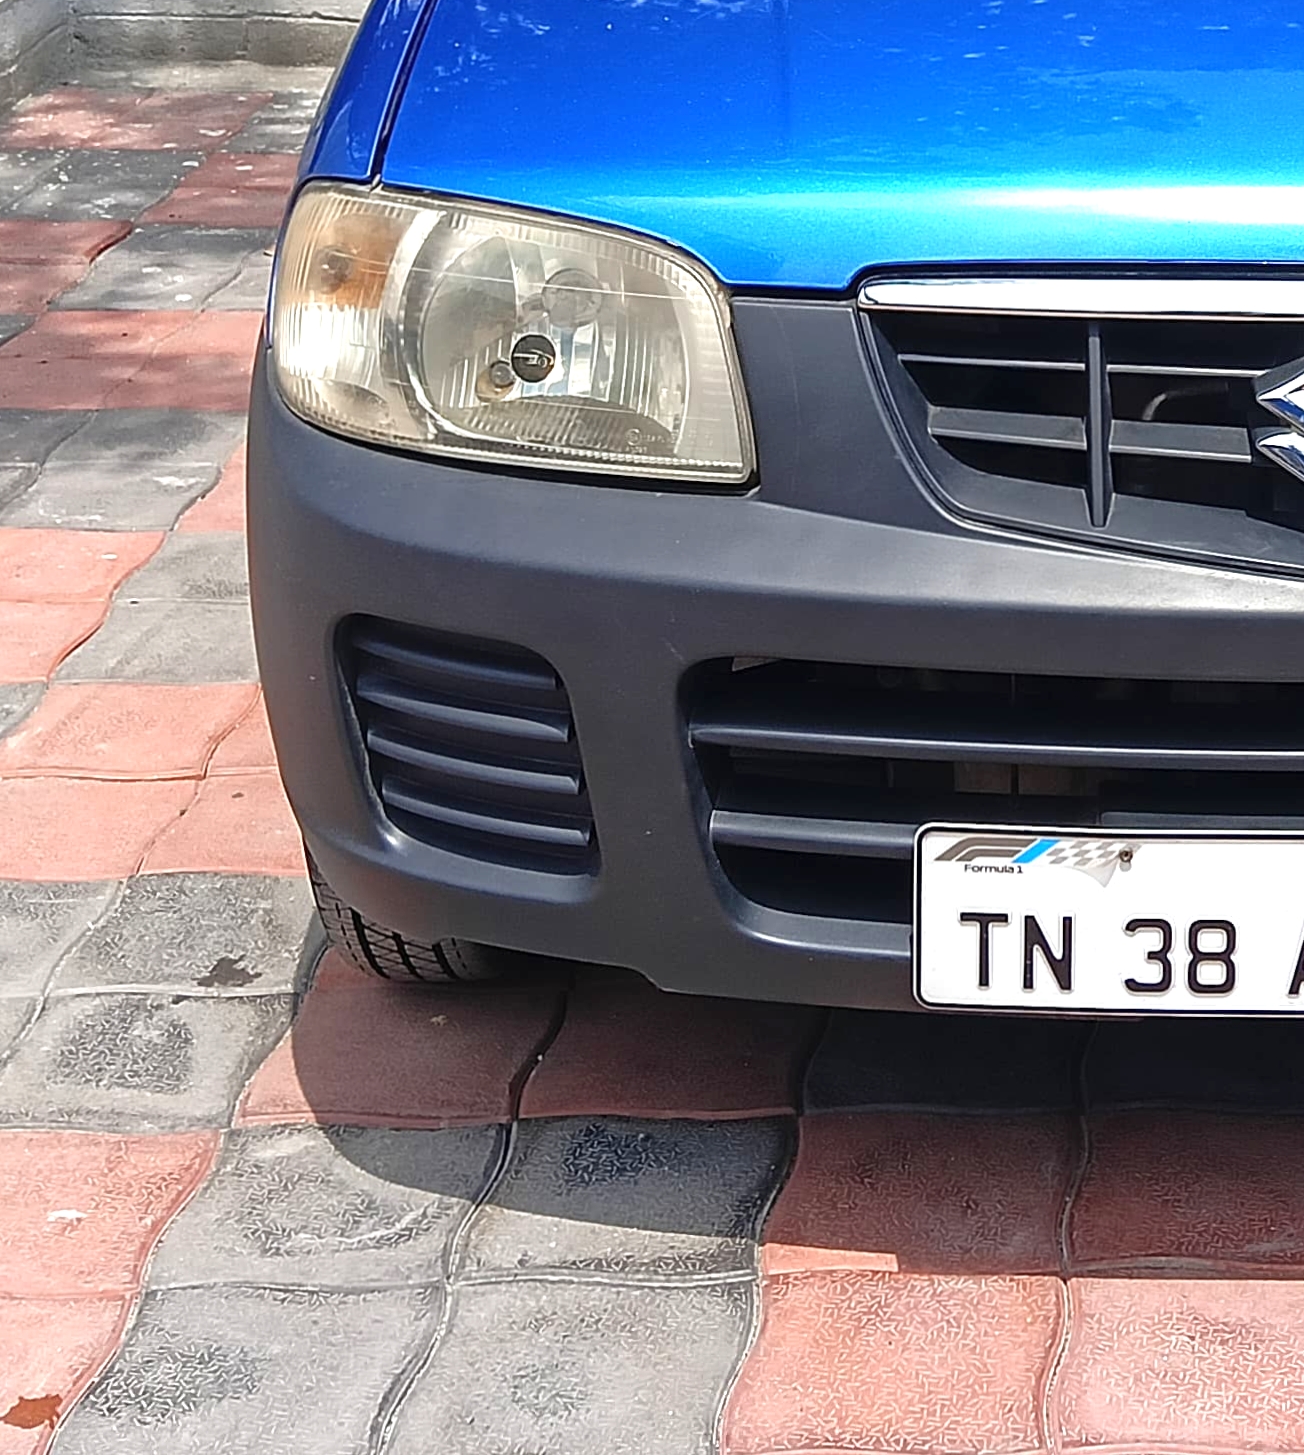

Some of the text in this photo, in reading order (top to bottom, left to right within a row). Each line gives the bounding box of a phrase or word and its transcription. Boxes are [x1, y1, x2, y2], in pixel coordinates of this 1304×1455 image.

[964, 864, 1024, 874] Formula 1
[959, 911, 1073, 991] TN
[1124, 918, 1237, 994] 38
